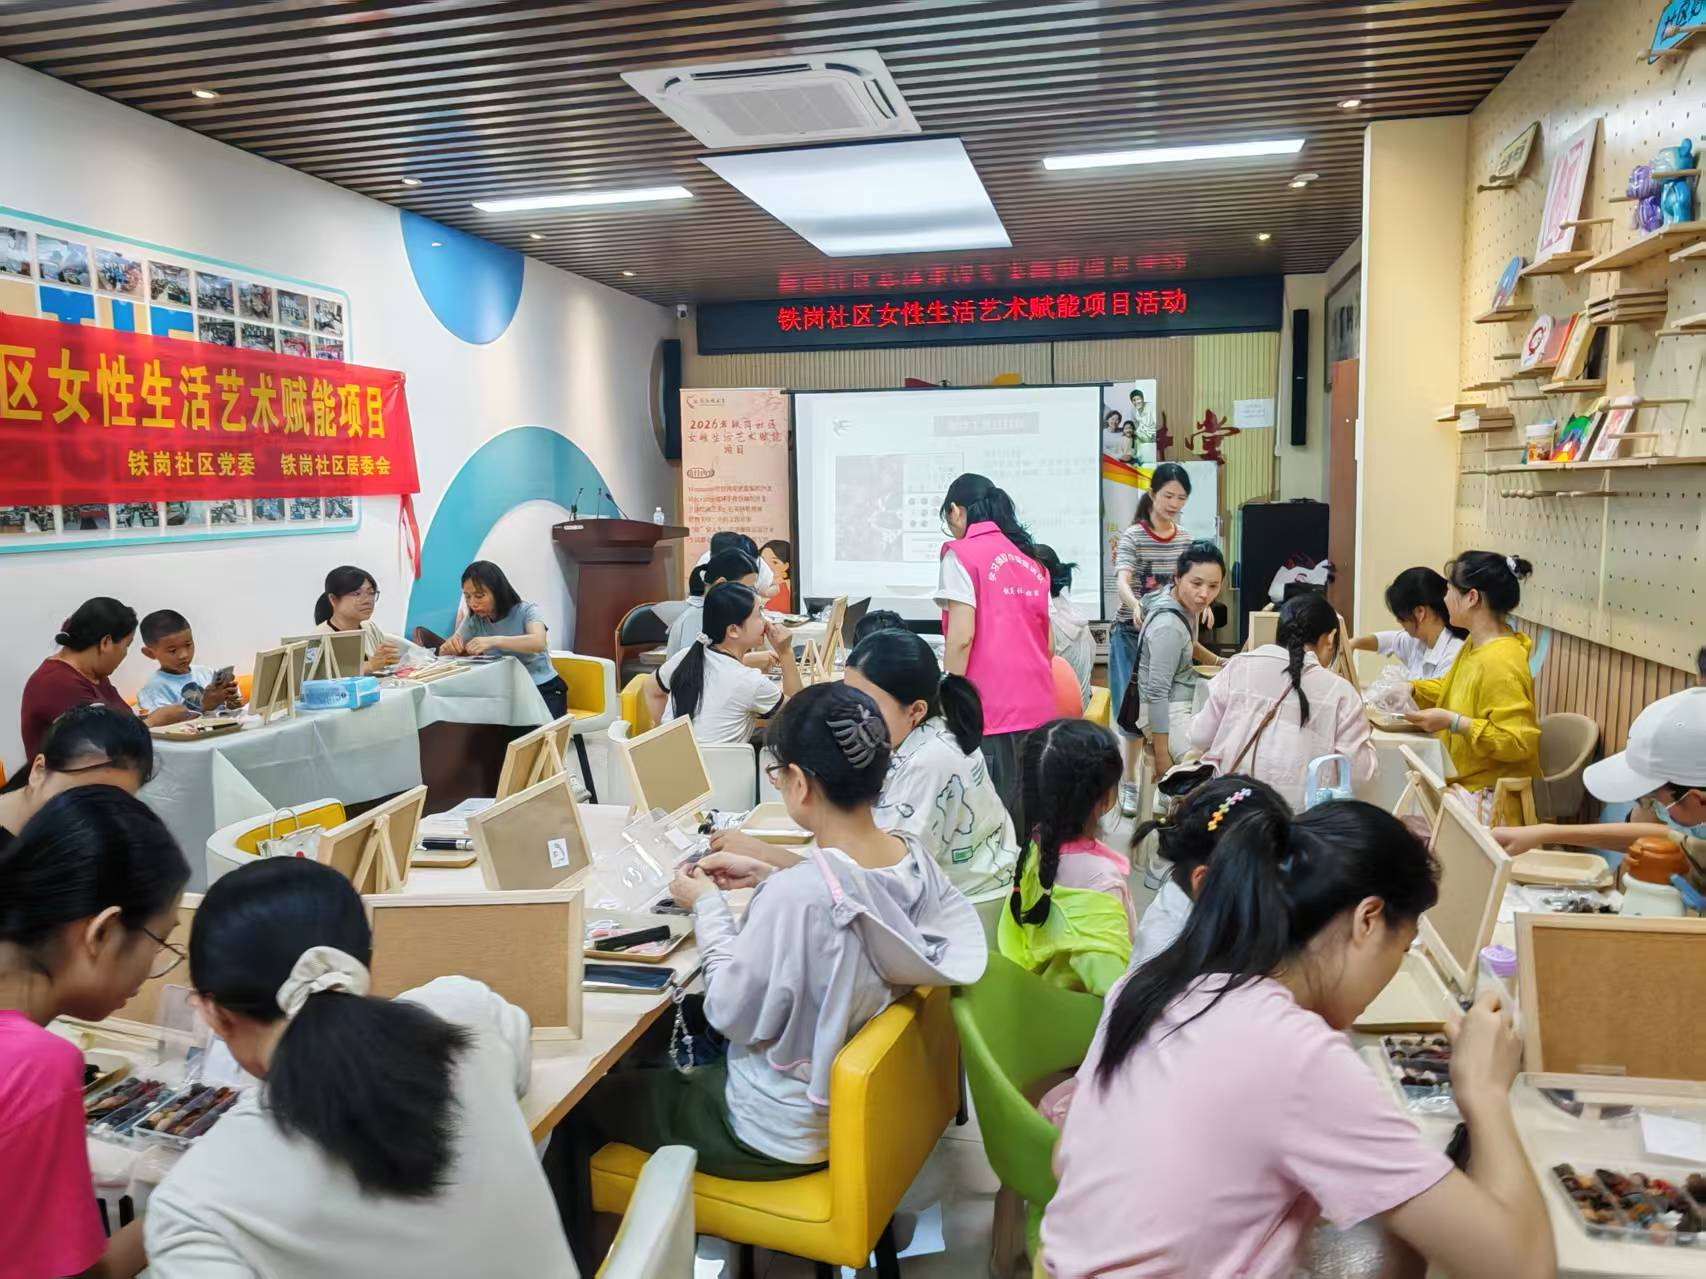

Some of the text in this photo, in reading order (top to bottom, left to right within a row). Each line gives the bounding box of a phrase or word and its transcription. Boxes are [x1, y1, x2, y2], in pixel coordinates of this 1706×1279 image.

[777, 288, 1187, 332] 铁岗社区女性生活艺术赋能项目活动
[0, 345, 386, 439] 区女性生活艺术赋能项目
[128, 450, 391, 476] 铁岗社区党委 铁岗社区居委会
